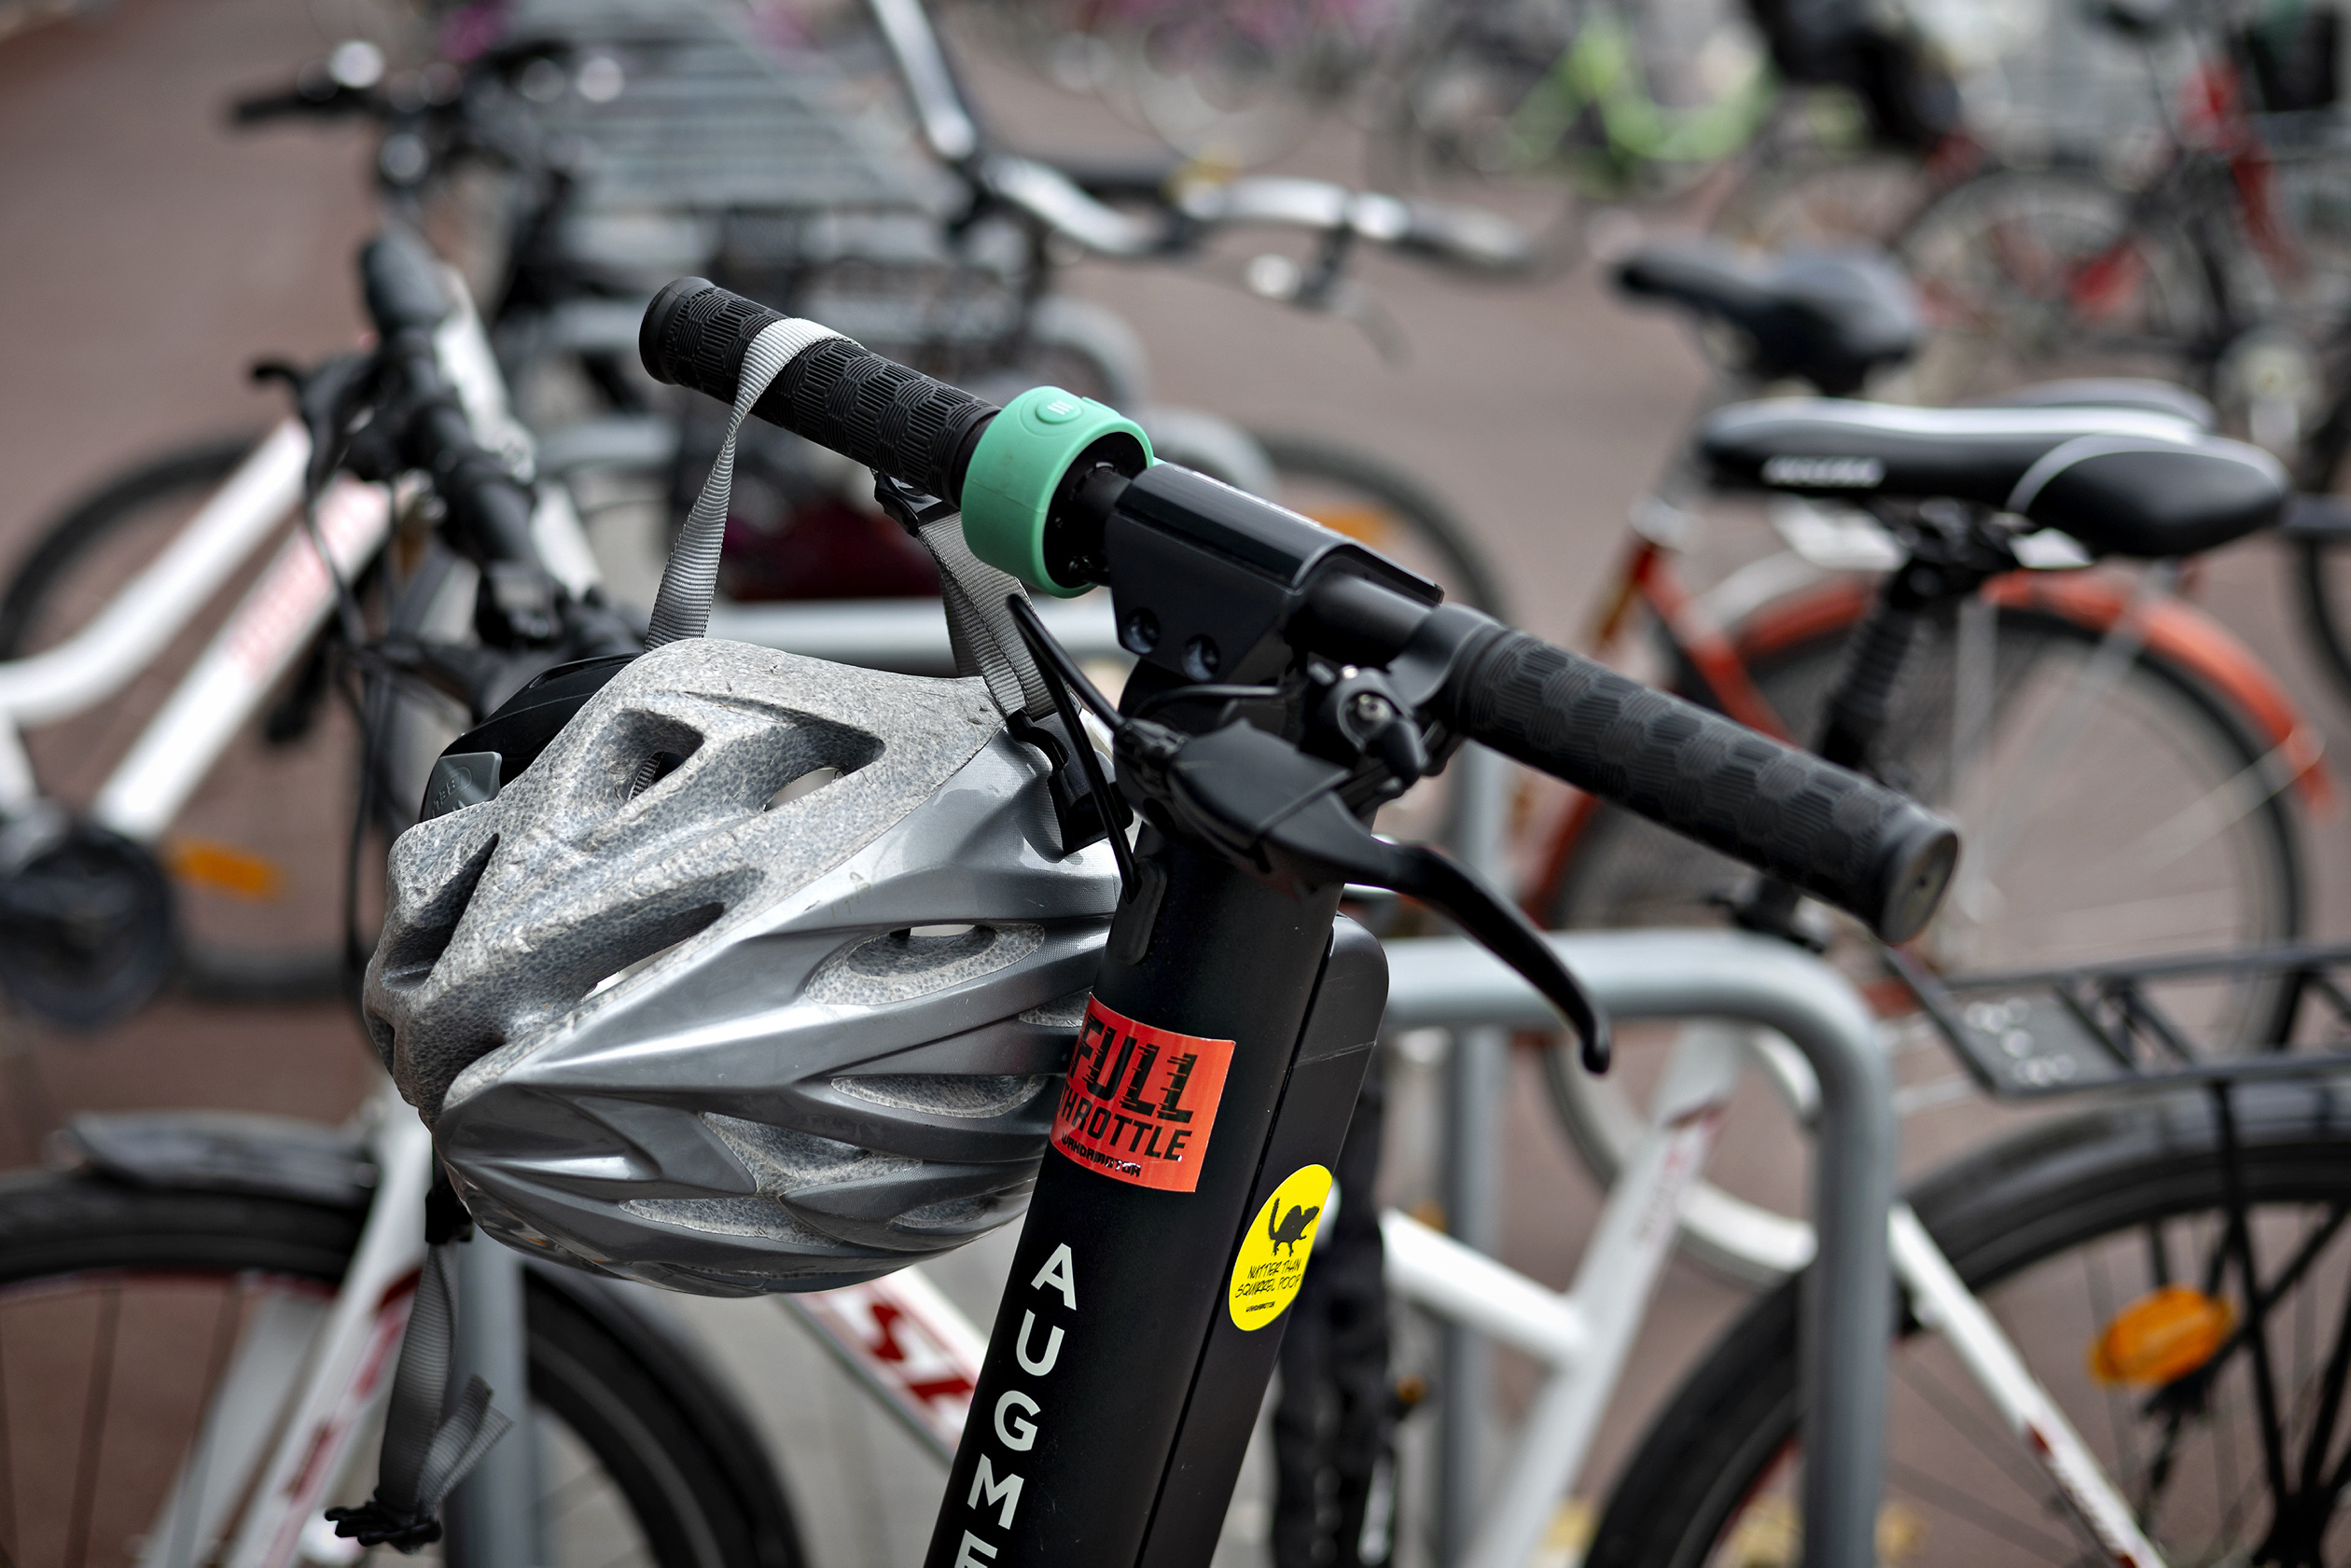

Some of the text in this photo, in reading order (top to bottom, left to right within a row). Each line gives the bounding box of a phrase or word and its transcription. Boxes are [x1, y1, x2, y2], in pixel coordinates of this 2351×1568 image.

[1068, 1012, 1199, 1124] FULL
[1060, 1081, 1193, 1161] THROTTLE
[1234, 1273, 1301, 1298] SQUIRREL POOP
[1246, 1257, 1302, 1280] NUTTER THAN
